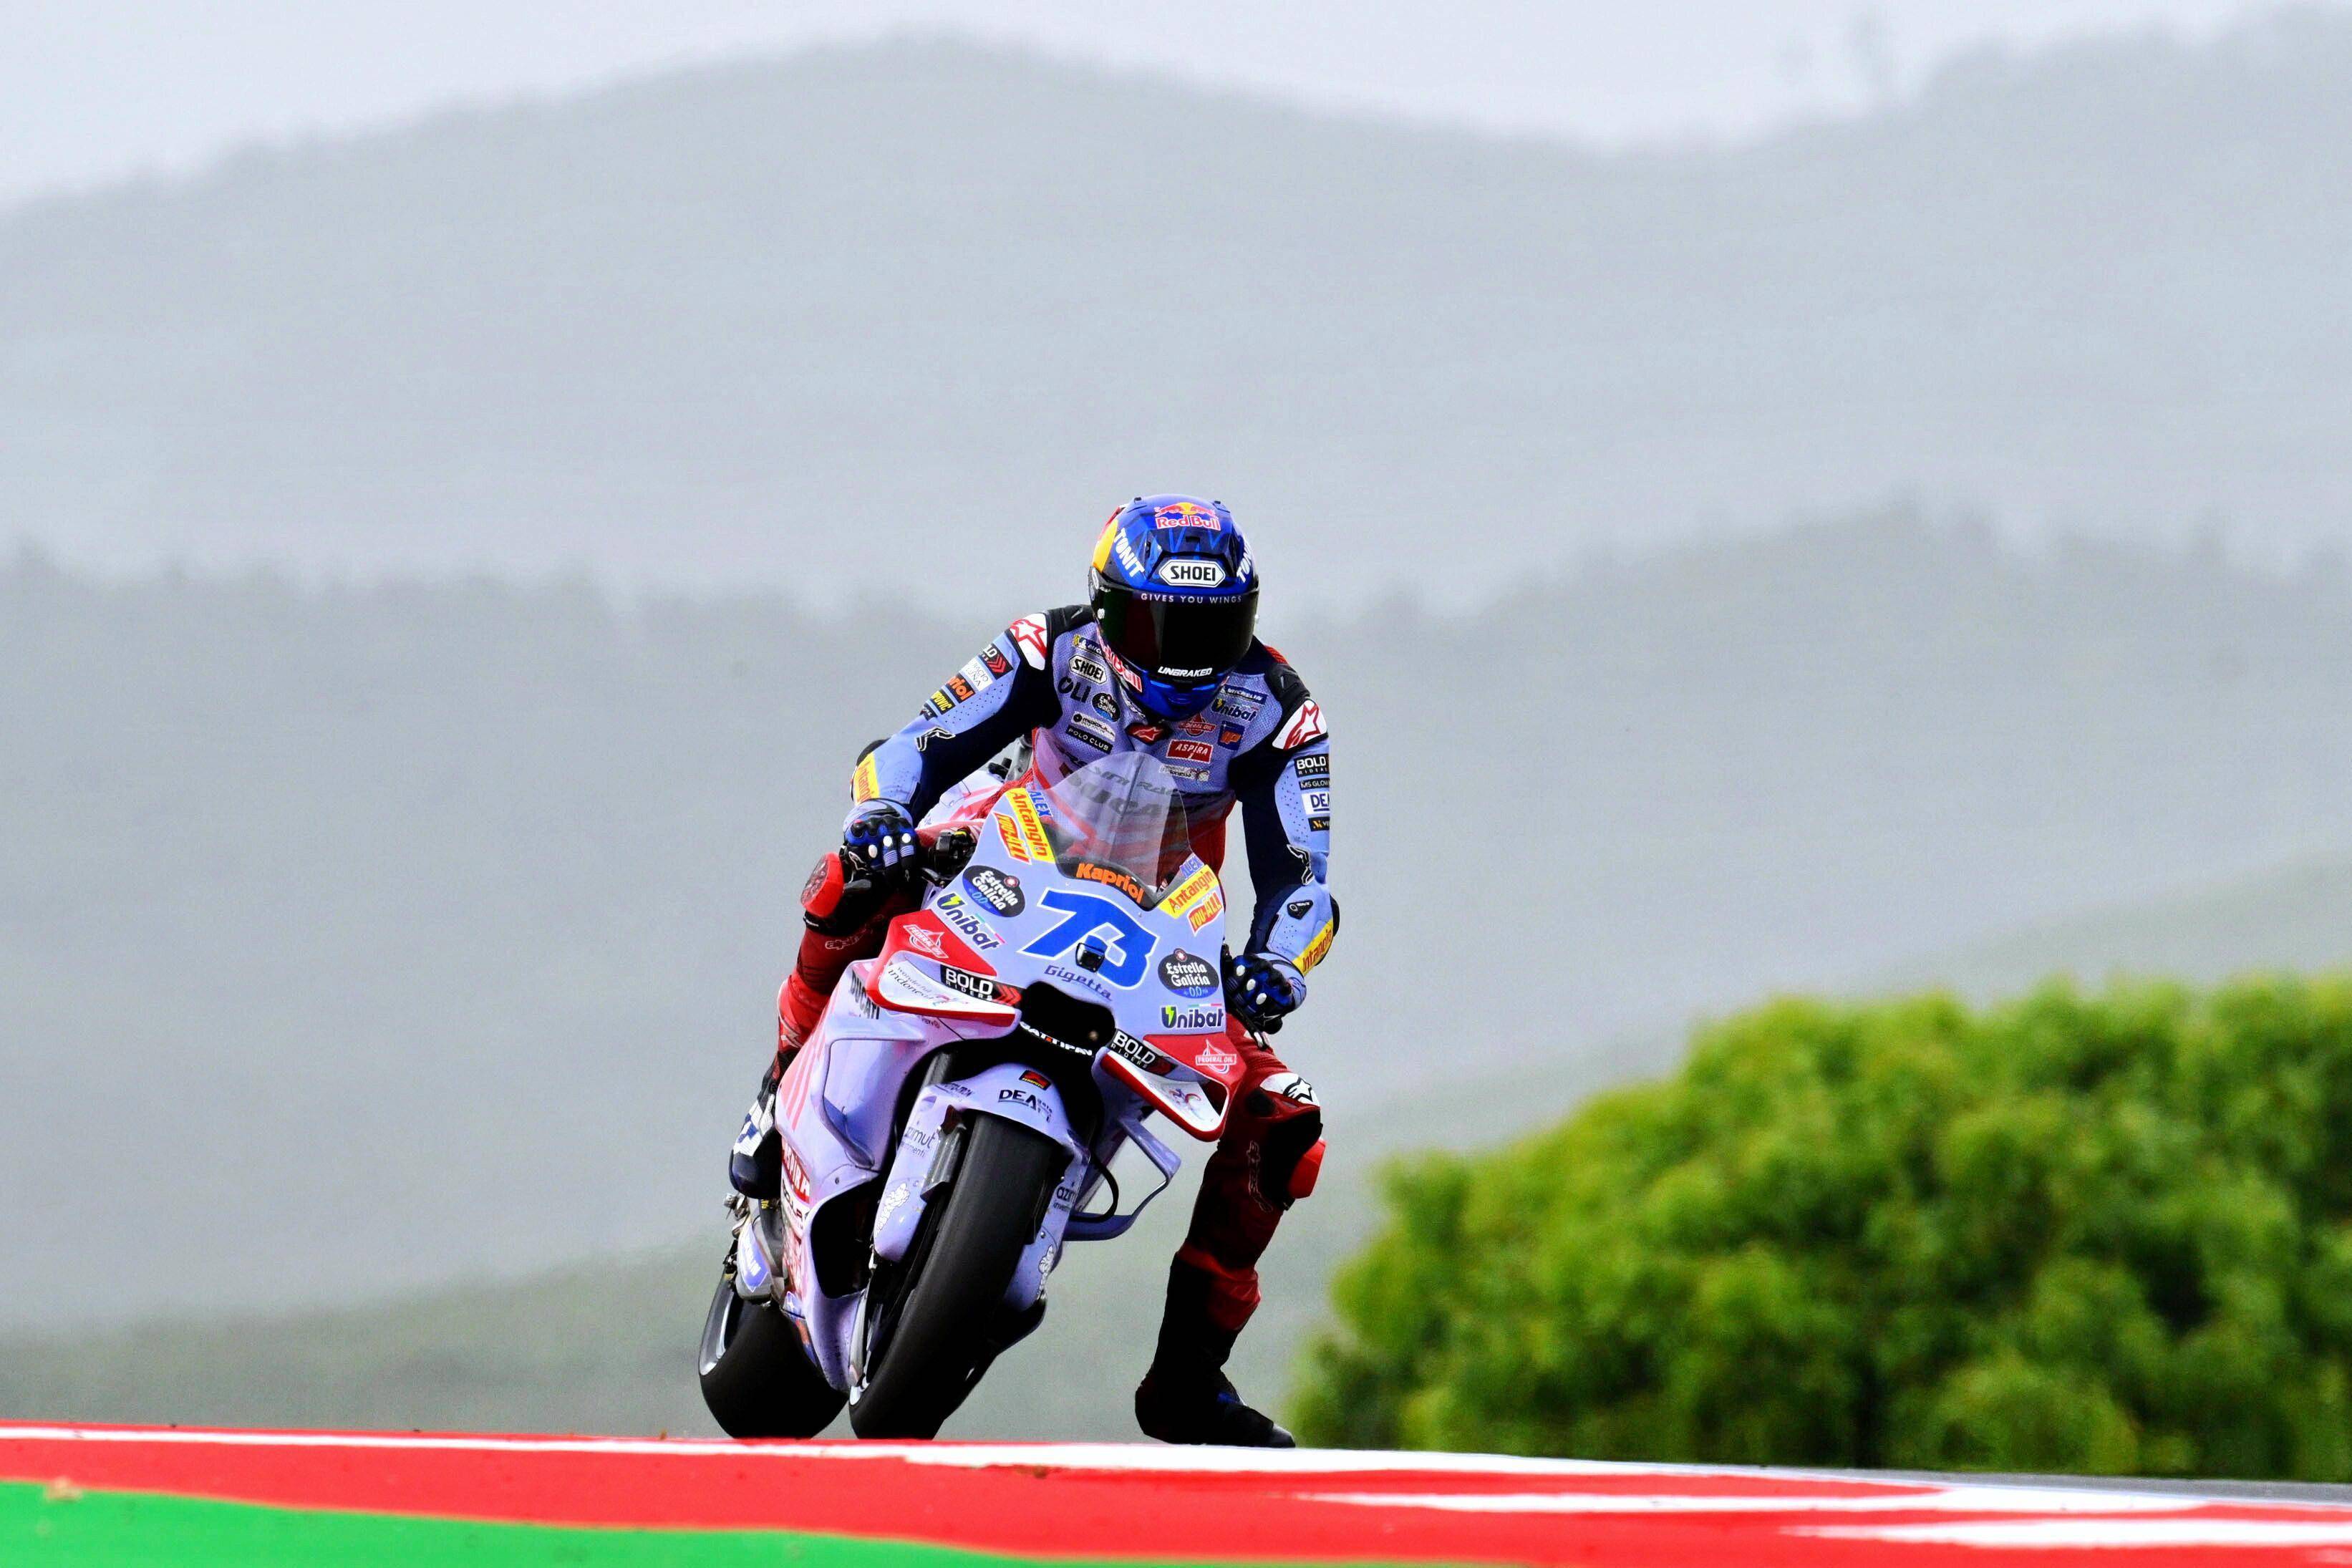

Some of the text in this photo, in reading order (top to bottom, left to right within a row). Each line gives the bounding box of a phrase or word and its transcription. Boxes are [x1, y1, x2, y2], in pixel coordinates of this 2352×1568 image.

[1156, 516, 1221, 530] Red Bull
[1113, 527, 1145, 578] TONIT
[1170, 566, 1216, 581] SHOEI
[1141, 593, 1174, 603] GIVES
[1181, 595, 1204, 604] YOU
[1073, 659, 1104, 681] SHOEI
[1158, 667, 1213, 677] UNBRAKED
[1211, 698, 1258, 722] Unibat
[1068, 728, 1108, 750] POLO CLUB
[1176, 744, 1209, 756] ASPIRA
[1297, 756, 1327, 770] BOLD
[1029, 790, 1051, 817] ALEX
[1012, 791, 1048, 856] Antangin
[972, 876, 1006, 911] Galicia
[979, 871, 1018, 906] Estrella
[1075, 863, 1144, 904] Kapriol
[1168, 871, 1214, 914] Antangin
[937, 893, 1000, 950] Unibat
[1017, 888, 1160, 989] 73
[1166, 962, 1207, 975] Estrella
[1171, 974, 1211, 987] Galicia
[946, 968, 994, 995] BOLD
[946, 980, 993, 1002] RIDERS
[1045, 965, 1113, 1001] Gigetta
[1161, 1005, 1224, 1028] Unibat
[1110, 1043, 1148, 1068] RIDERS
[1113, 1031, 1156, 1065] BOLD
